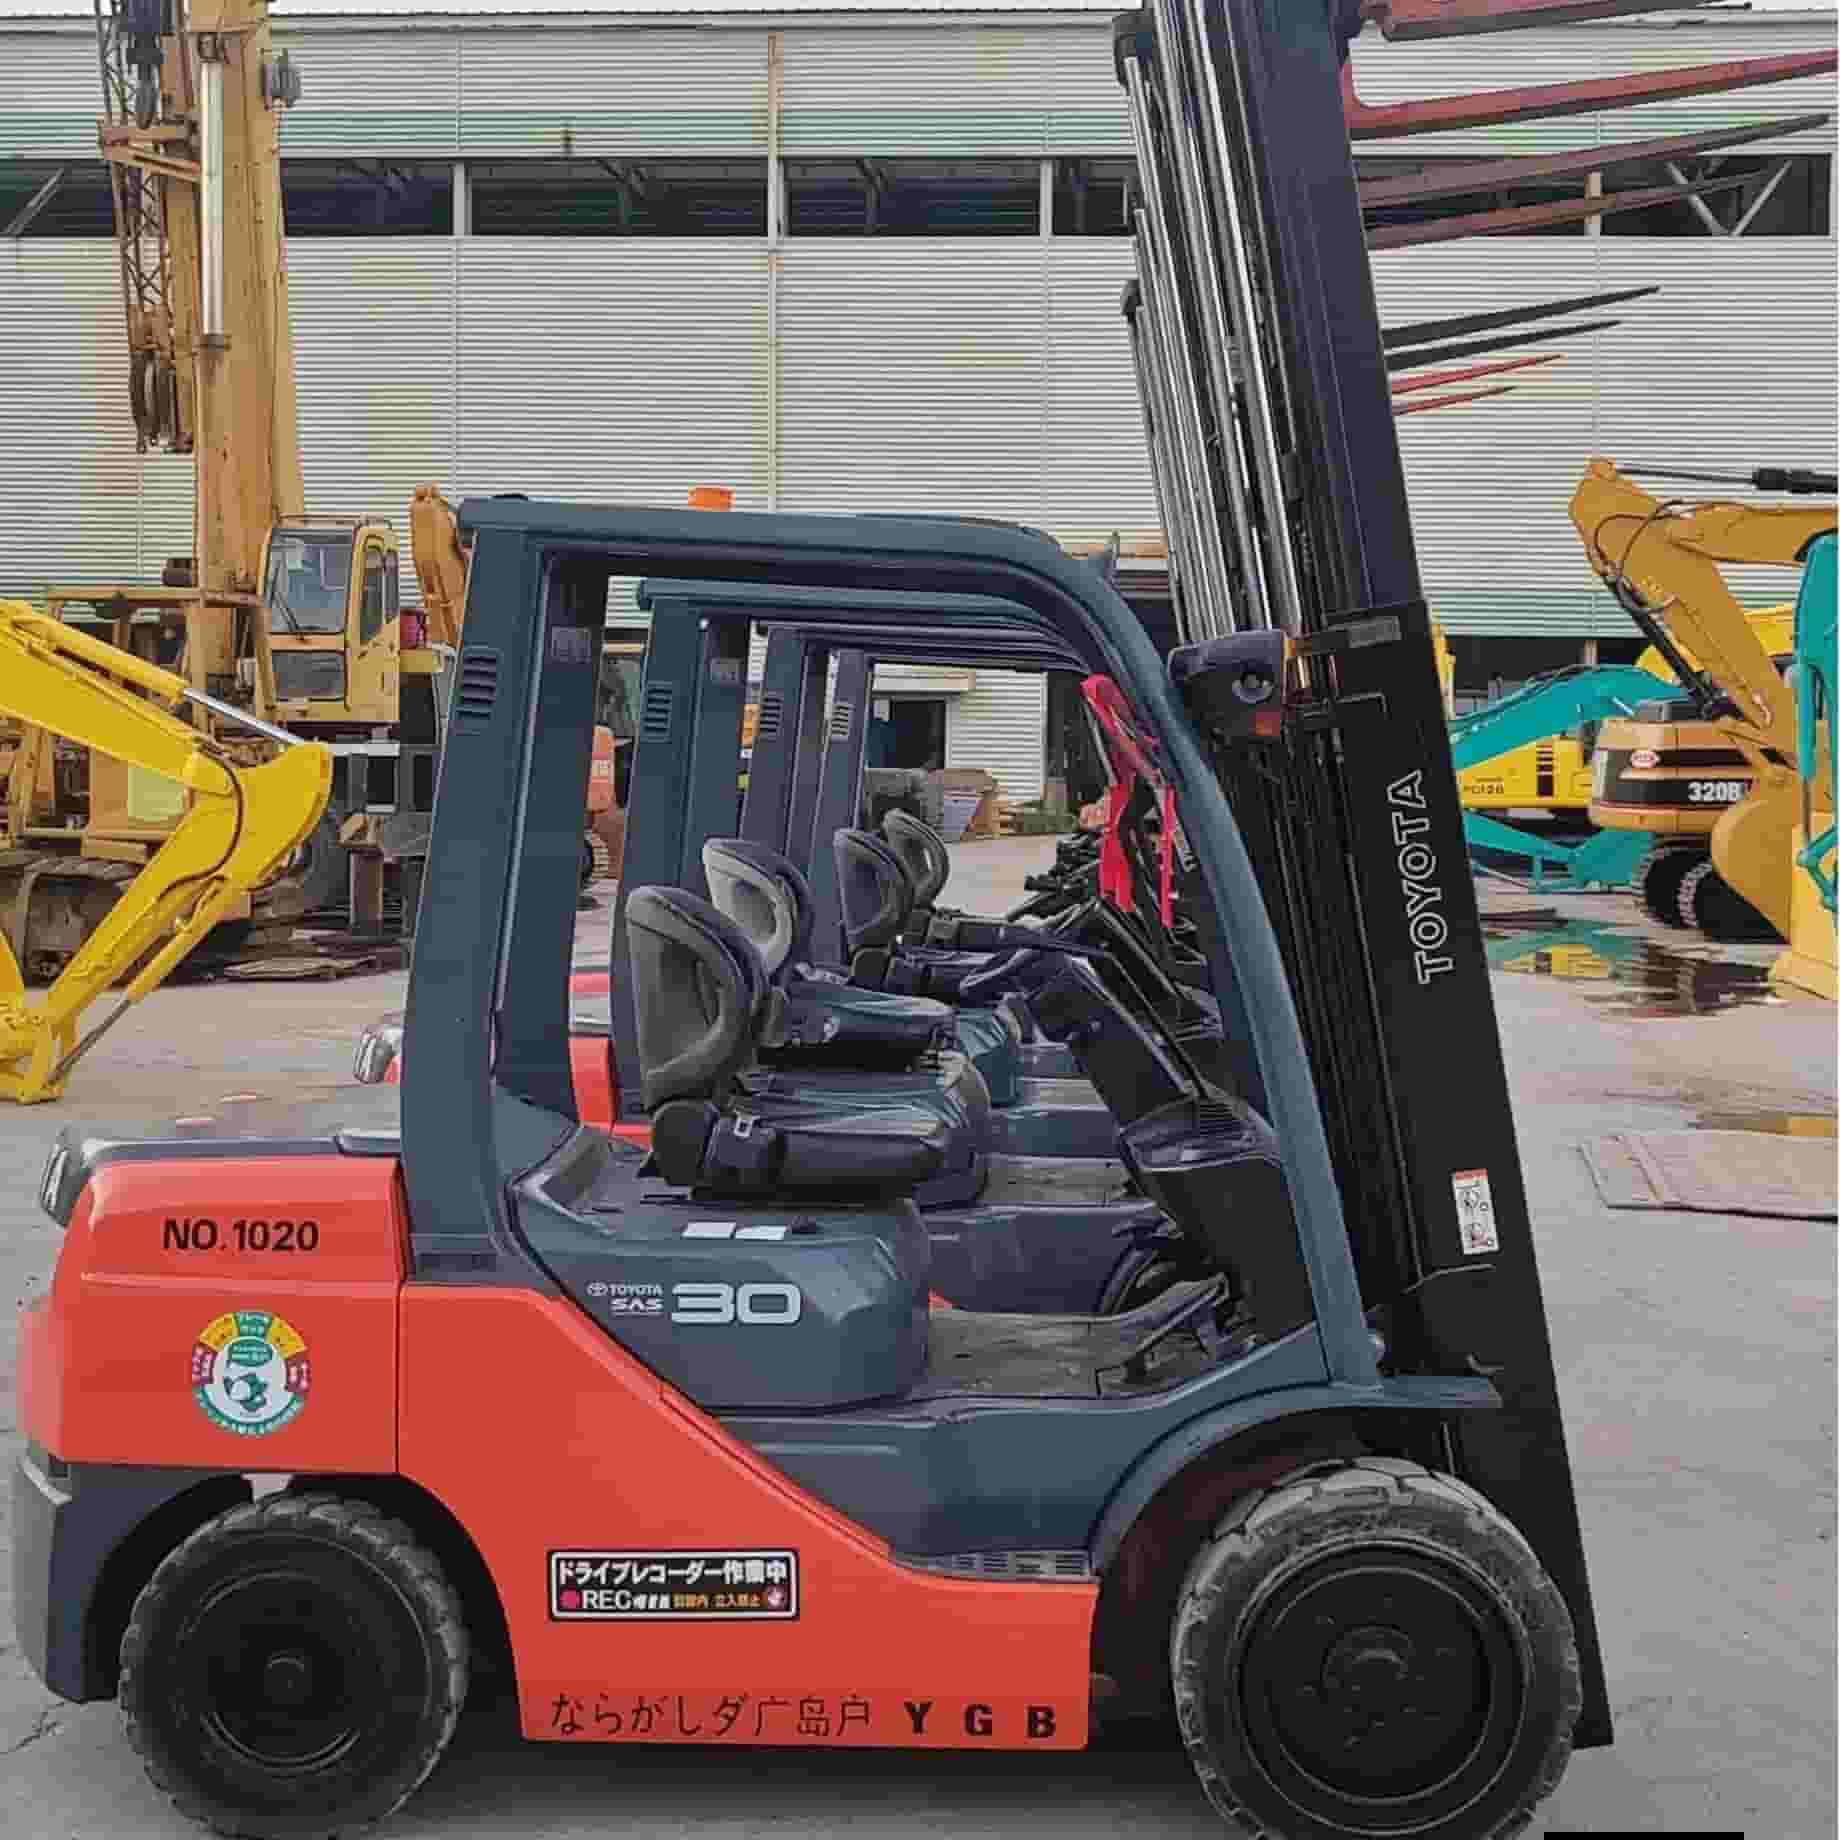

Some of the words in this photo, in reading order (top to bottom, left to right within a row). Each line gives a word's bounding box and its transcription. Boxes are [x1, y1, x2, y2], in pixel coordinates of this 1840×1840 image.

[1387, 769, 1453, 984] TOYOTA
[162, 1218, 320, 1251] NO.1020
[609, 1283, 663, 1297] TOYOTA
[671, 1282, 801, 1324] 30
[610, 1297, 664, 1312] SAS
[582, 1589, 632, 1610] REC
